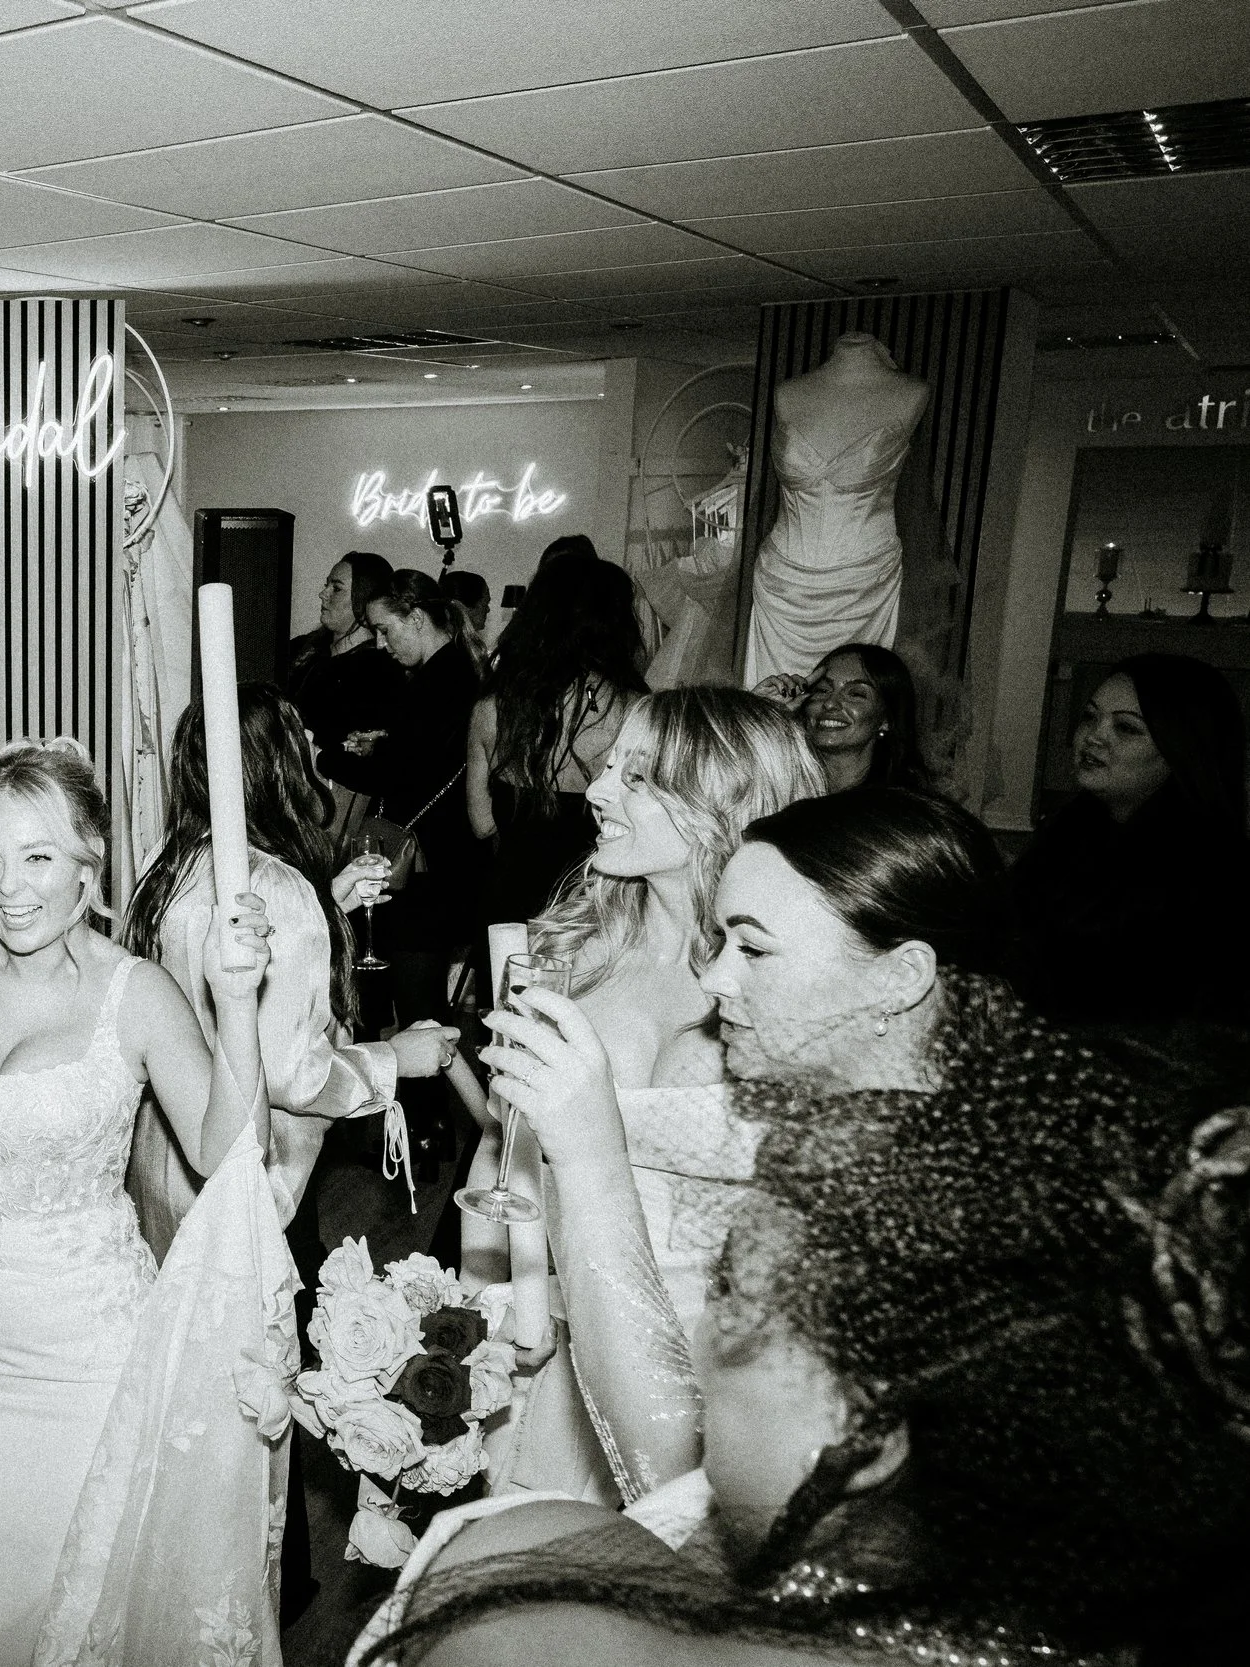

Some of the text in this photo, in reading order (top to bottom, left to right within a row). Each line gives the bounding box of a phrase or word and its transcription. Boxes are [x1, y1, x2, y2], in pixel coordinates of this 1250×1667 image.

[352, 462, 567, 529] Brid to be
